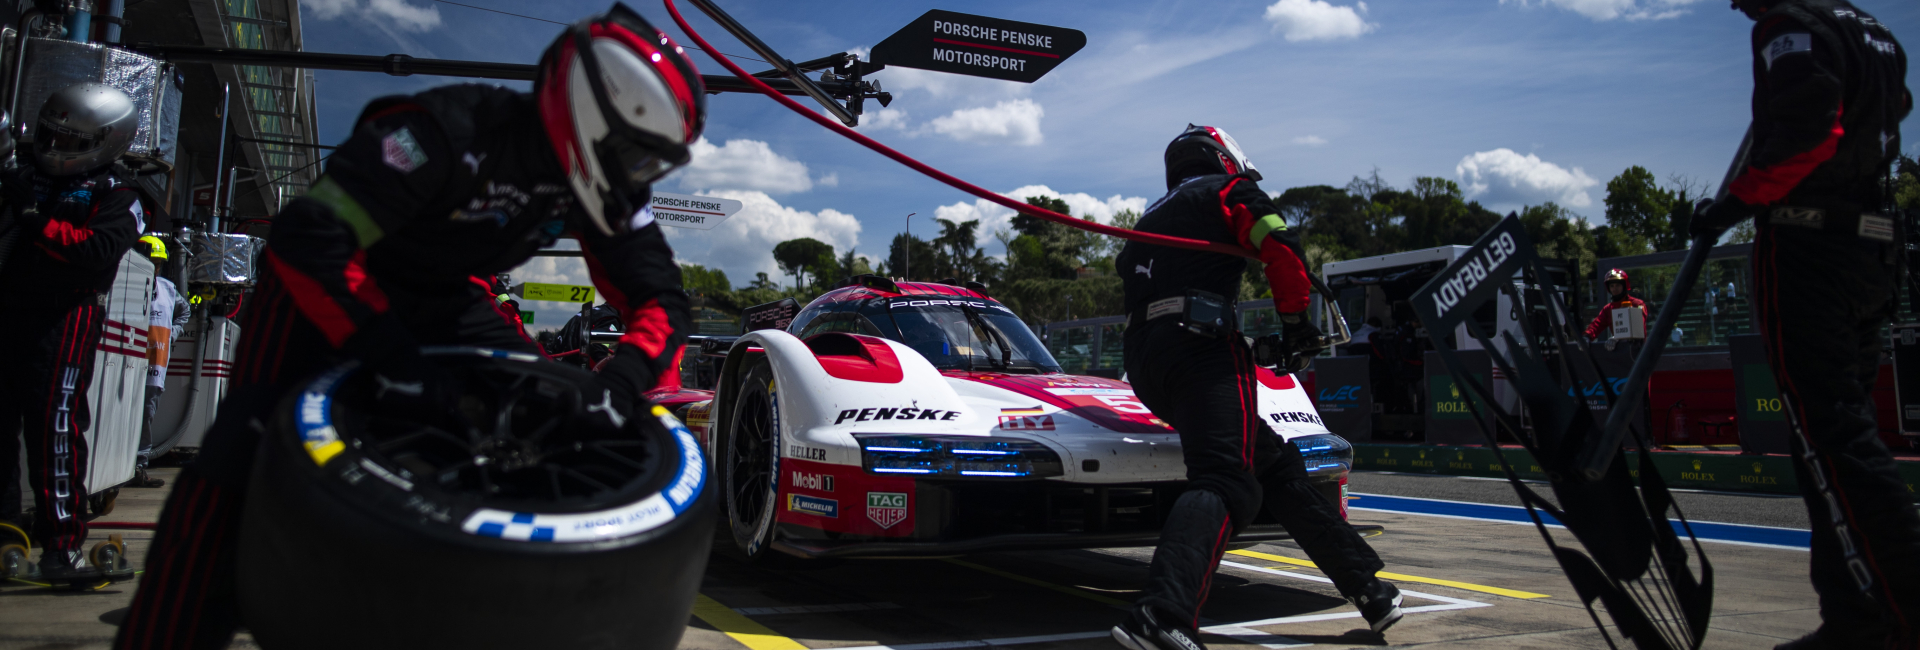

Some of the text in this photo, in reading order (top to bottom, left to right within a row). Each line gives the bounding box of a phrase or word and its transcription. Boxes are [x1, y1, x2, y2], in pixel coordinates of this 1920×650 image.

[933, 20, 1053, 49] PORSCHE PENSKE
[932, 47, 1027, 72] MOTORSPORT
[652, 196, 722, 211] PORSCHE PENSKE
[652, 211, 705, 224] MOTORSPORT
[1432, 231, 1516, 318] GET READY
[570, 286, 591, 302] 27
[750, 305, 793, 324] PORSCHE
[1319, 385, 1361, 401] WEC
[1092, 395, 1152, 414] 5
[834, 408, 961, 425] PENSKE
[1001, 416, 1049, 429] HY
[1270, 412, 1323, 427] PENSKE
[54, 366, 81, 522] PORSCHE
[771, 405, 780, 485] MICHELIN
[790, 445, 826, 461] HELLER
[1412, 459, 1434, 468] ROLEX
[1449, 461, 1473, 470] ROLEX
[792, 470, 822, 490] Mobil
[1681, 471, 1715, 481] ROLEX
[1740, 475, 1777, 485] ROLEX
[801, 501, 834, 512] MICHELIN
[870, 494, 904, 506] TAG
[869, 507, 905, 526] HEUER
